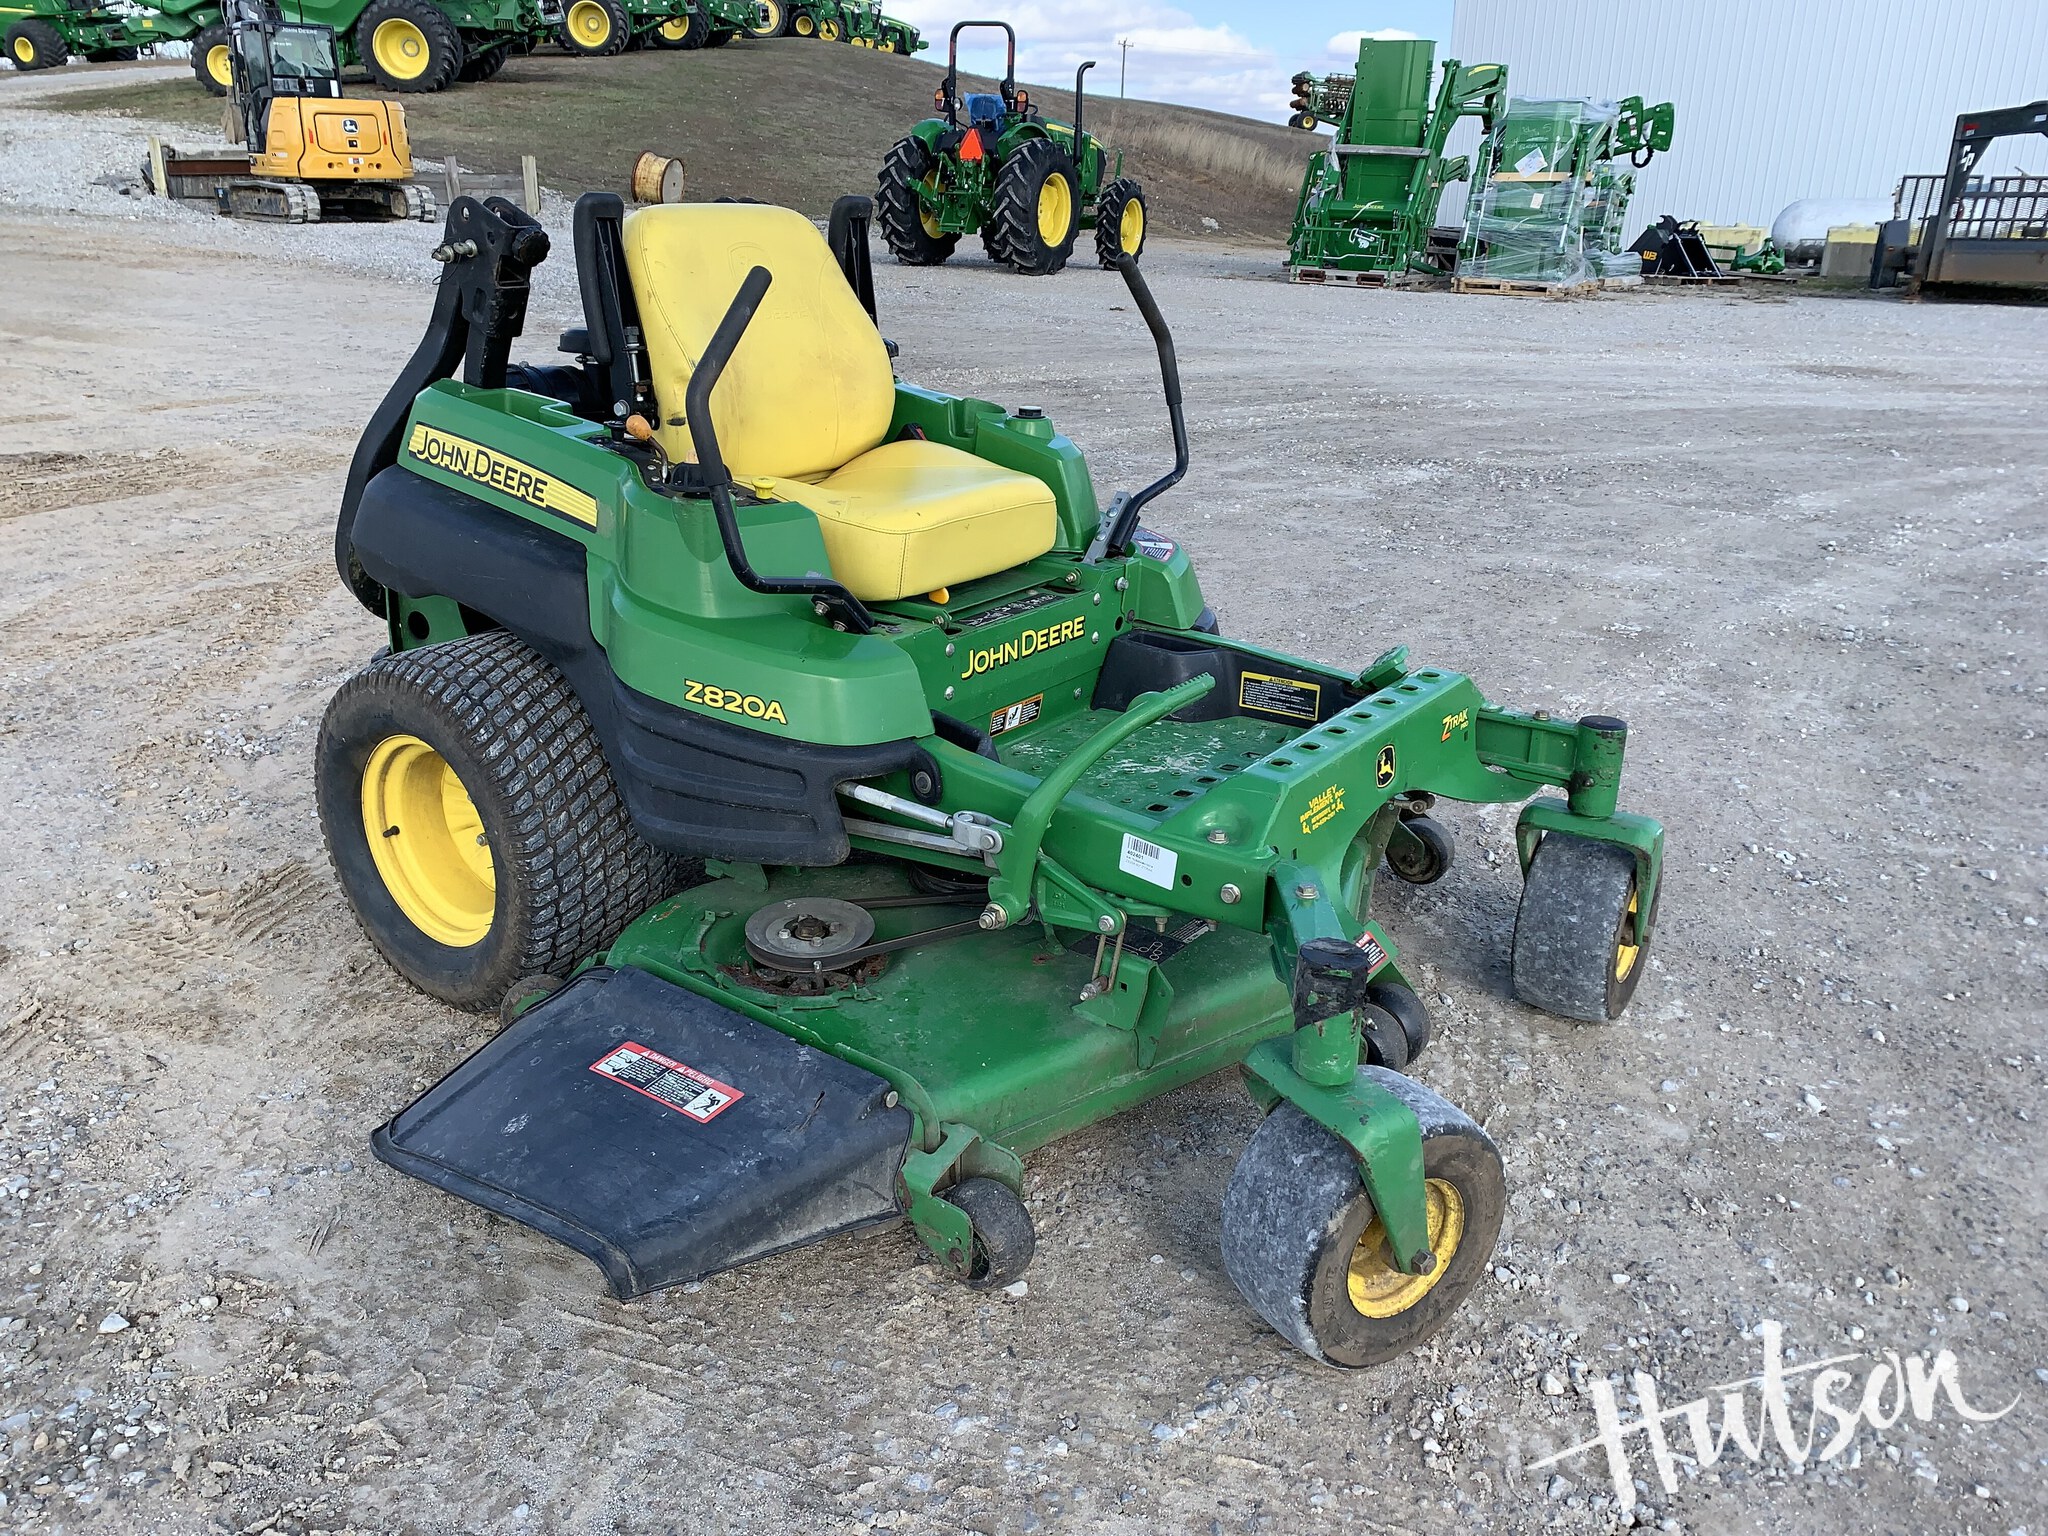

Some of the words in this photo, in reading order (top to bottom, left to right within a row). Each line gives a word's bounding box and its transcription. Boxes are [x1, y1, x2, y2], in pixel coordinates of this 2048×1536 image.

[416, 430, 470, 473] JOHN
[473, 448, 549, 503] DEERE
[961, 639, 1018, 680] JOHN
[1021, 615, 1086, 658] DEERE
[684, 679, 788, 725] Z820A
[1308, 783, 1337, 809] VALLEY
[648, 1050, 678, 1068] DANGER
[684, 1067, 715, 1086] PELIGRO
